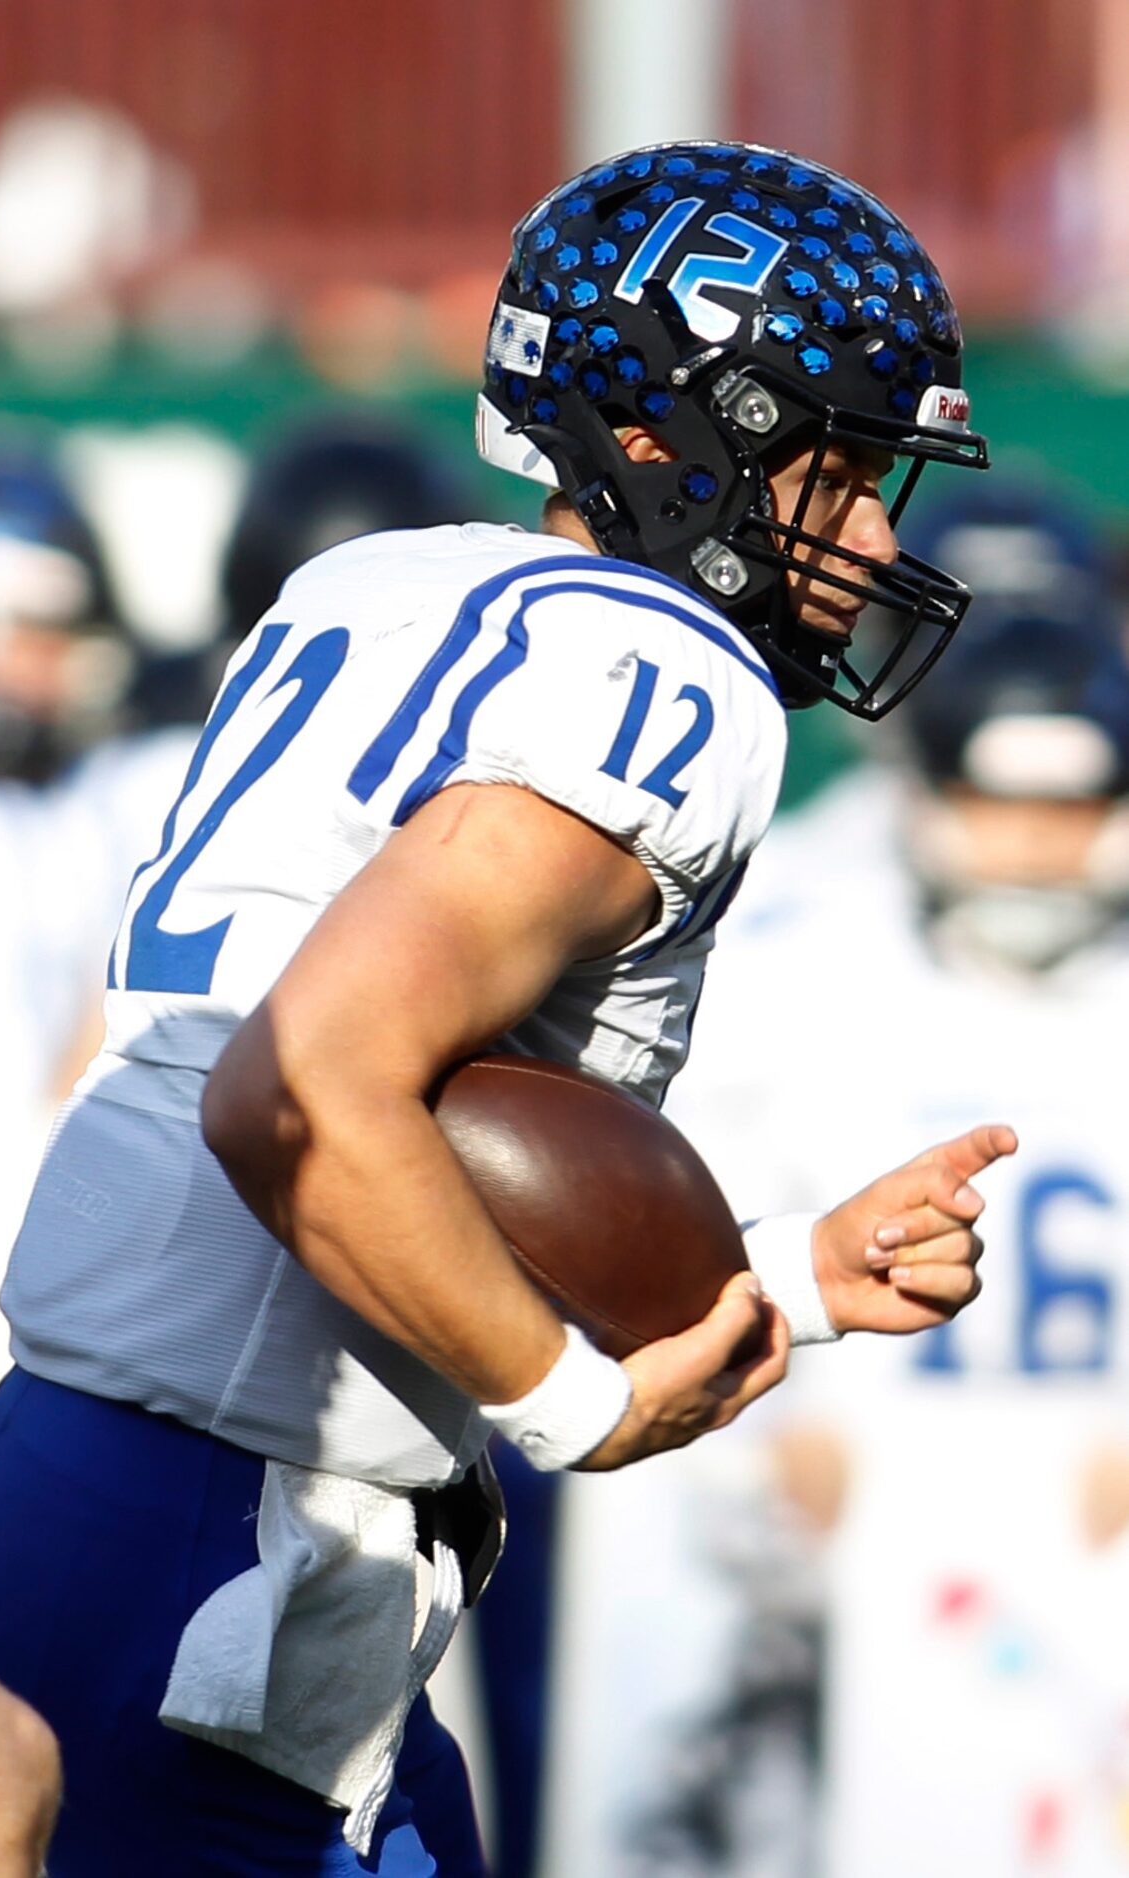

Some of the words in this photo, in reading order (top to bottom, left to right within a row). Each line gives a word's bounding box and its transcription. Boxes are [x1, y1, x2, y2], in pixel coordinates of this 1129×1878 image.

[613, 197, 790, 343] 12
[106, 622, 350, 996] 12
[596, 650, 715, 812] 12
